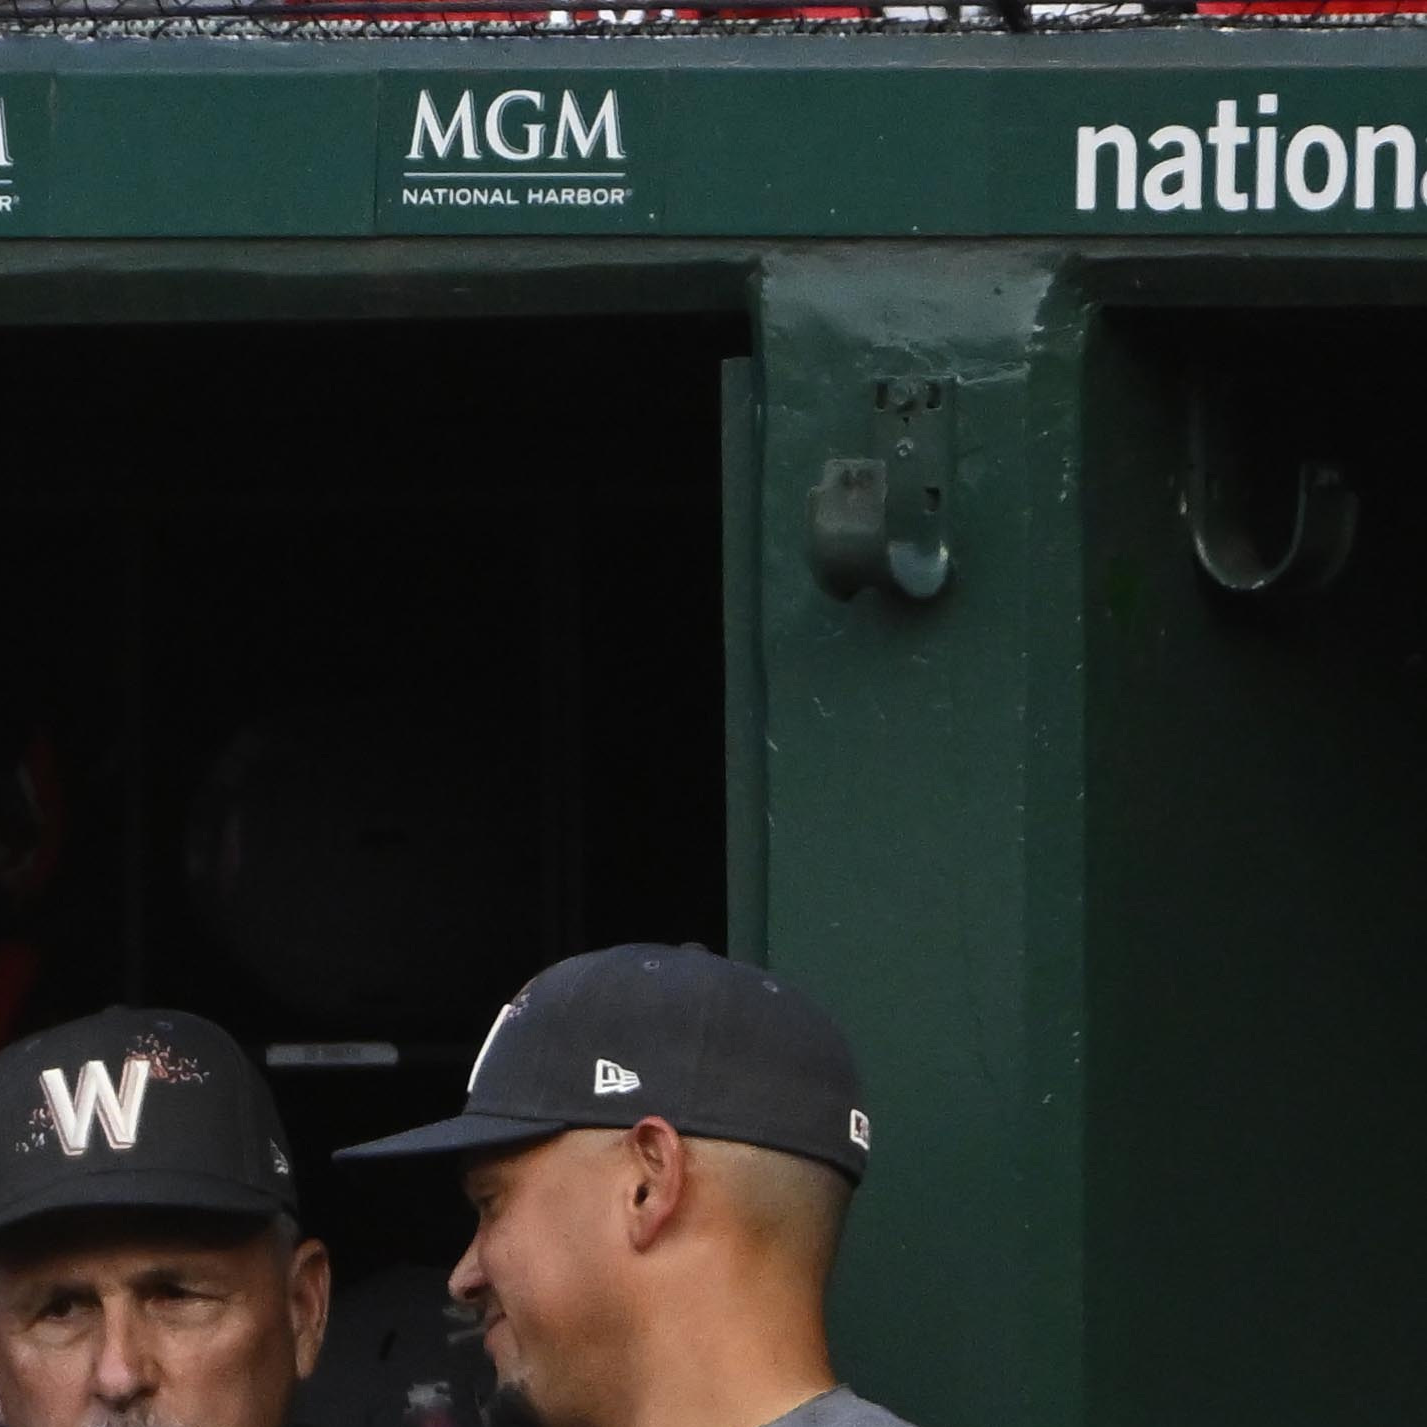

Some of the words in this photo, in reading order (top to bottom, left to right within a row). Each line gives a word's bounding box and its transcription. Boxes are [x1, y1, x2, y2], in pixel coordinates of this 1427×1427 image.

[405, 89, 627, 161] MGM
[1076, 94, 1427, 212] nation
[402, 188, 520, 206] NATIONAL
[40, 1059, 151, 1156] W
